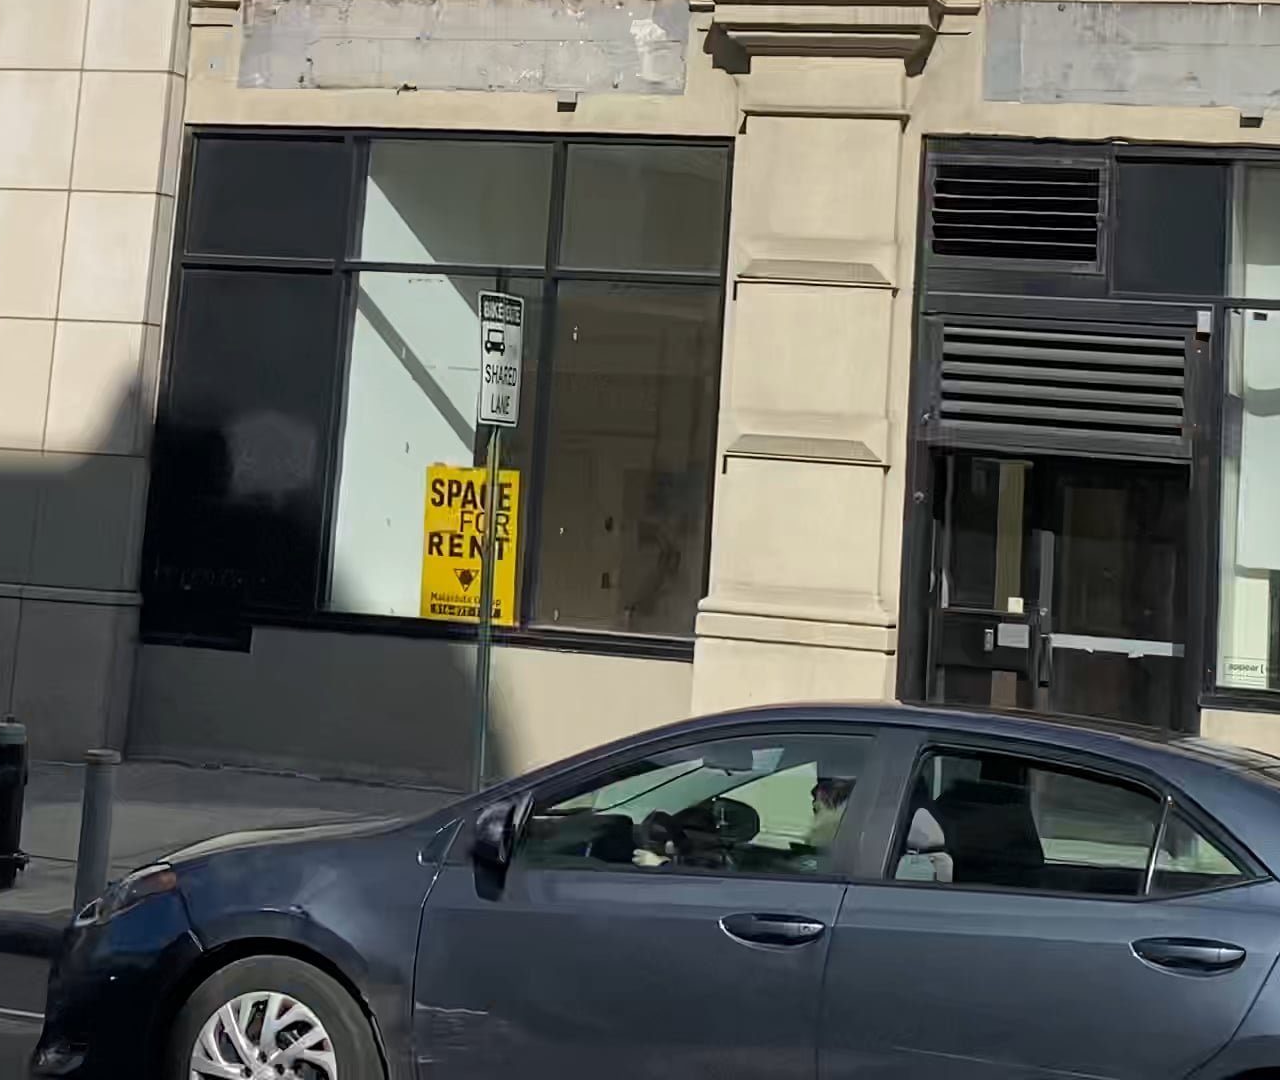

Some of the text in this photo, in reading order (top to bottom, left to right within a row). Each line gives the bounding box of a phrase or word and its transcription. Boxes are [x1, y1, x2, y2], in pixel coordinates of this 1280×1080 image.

[485, 364, 518, 387] SHARED
[491, 393, 511, 416] LANE
[427, 531, 510, 561] RENT
